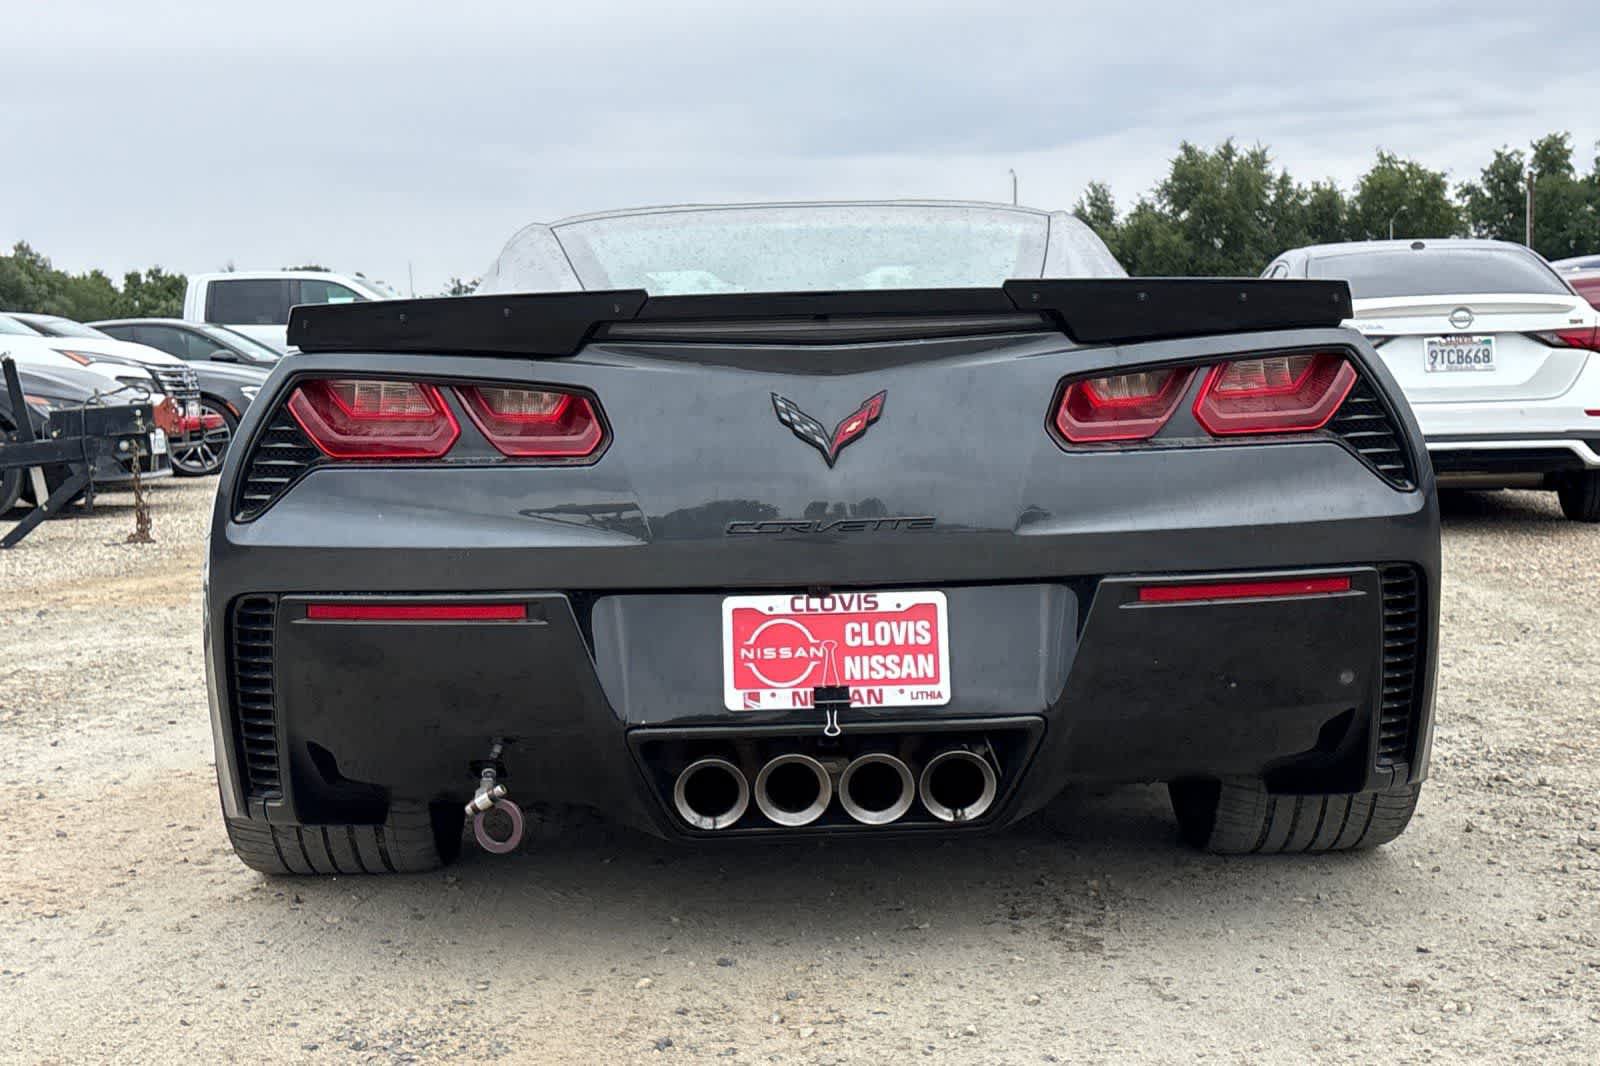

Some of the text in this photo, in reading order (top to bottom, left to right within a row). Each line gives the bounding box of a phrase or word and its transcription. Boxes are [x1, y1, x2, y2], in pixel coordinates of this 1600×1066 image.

[1430, 348, 1490, 365] 9TCB668
[726, 516, 937, 534] CORVETTE
[790, 593, 879, 612] CLOVIS
[844, 620, 932, 647] CLOVIS
[740, 646, 824, 660] NISSAN
[844, 654, 934, 680] NISSAN
[792, 688, 884, 706] NIAN
[910, 690, 943, 701] LITHIA
